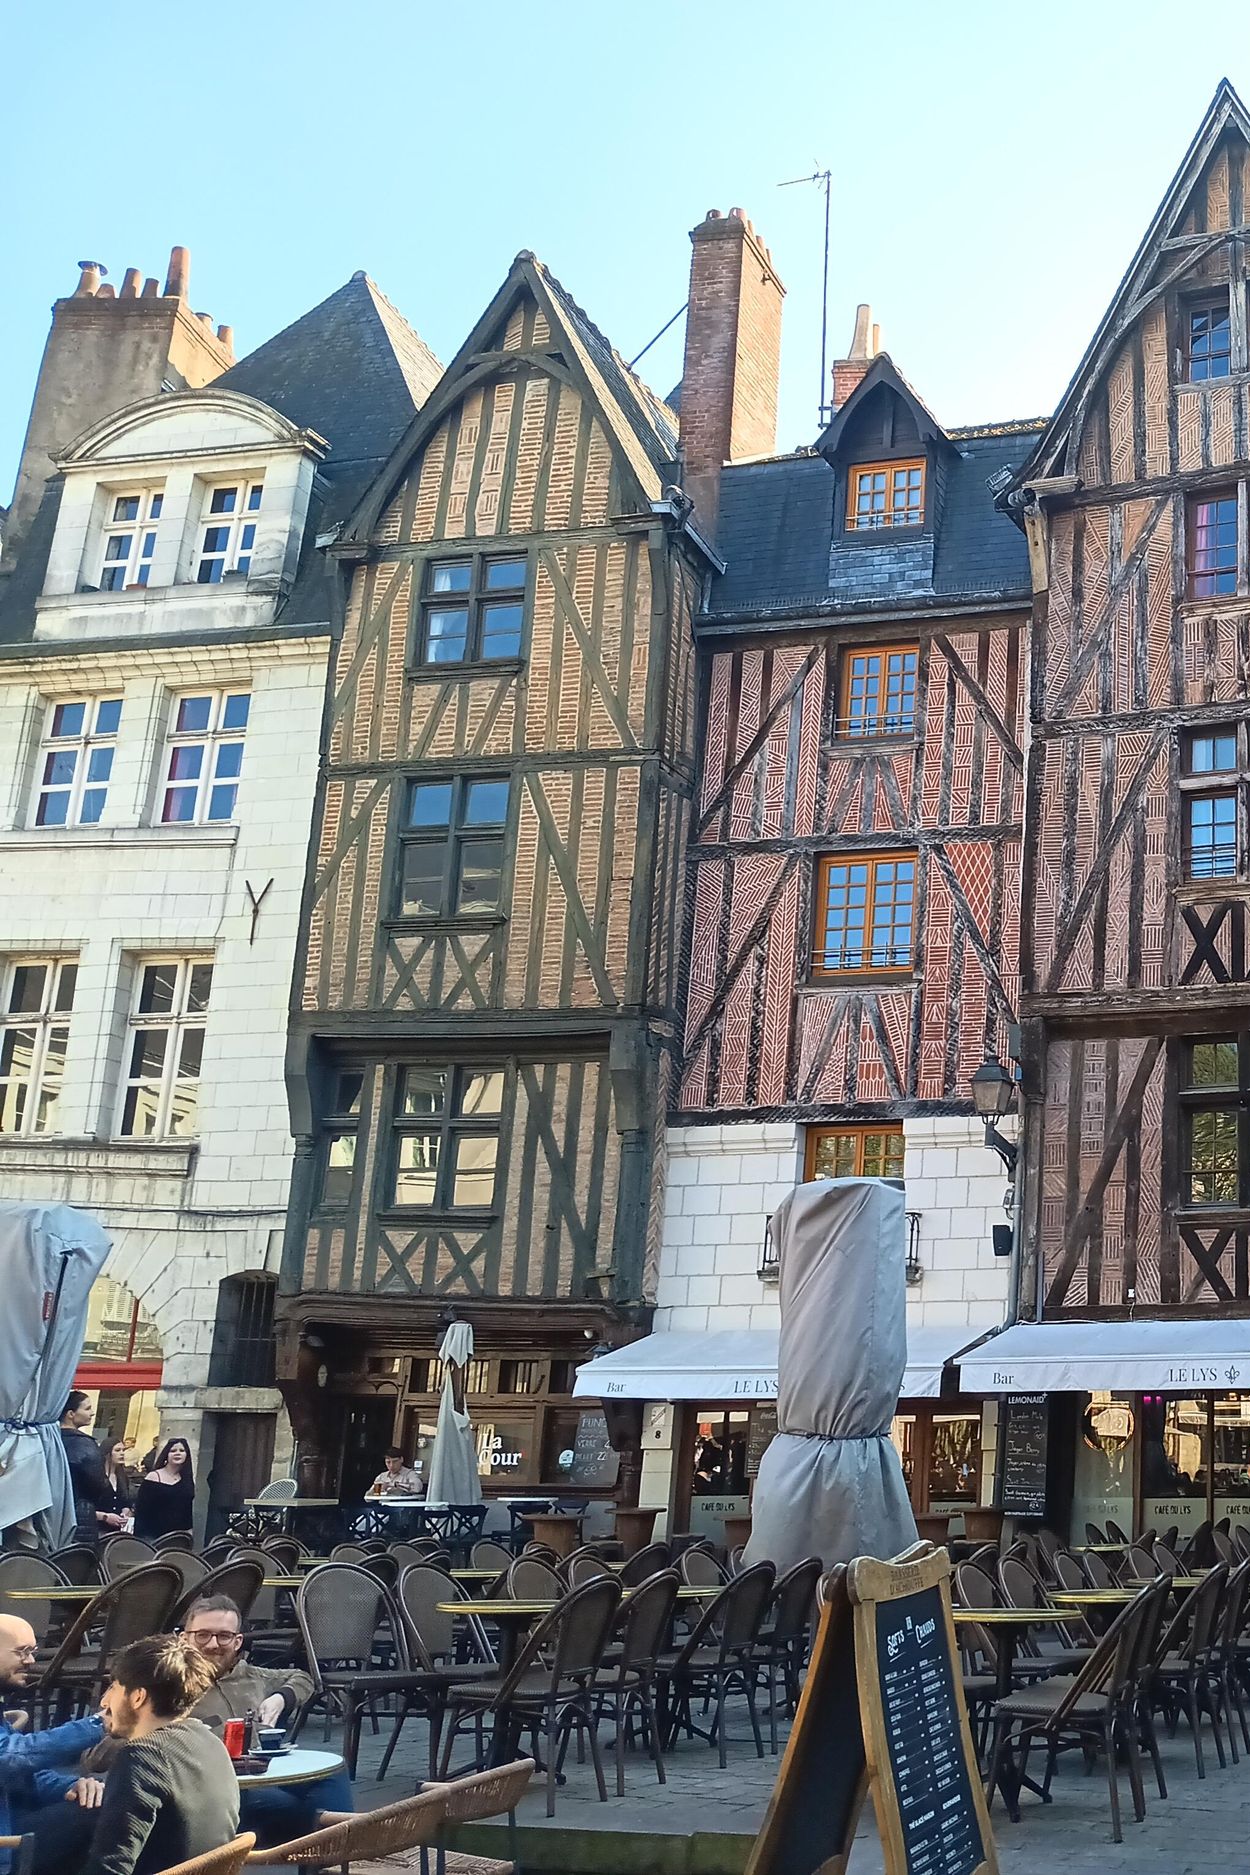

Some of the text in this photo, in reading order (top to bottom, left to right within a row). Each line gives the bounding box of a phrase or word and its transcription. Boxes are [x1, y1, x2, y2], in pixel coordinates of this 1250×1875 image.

[993, 1372, 1015, 1385] Bar
[1169, 1367, 1217, 1382] LE LYS
[606, 1381, 626, 1393] Bar
[733, 1380, 779, 1394] LE LYS
[481, 1433, 503, 1449] La
[654, 1430, 662, 1440] 8
[478, 1449, 523, 1466] Cour
